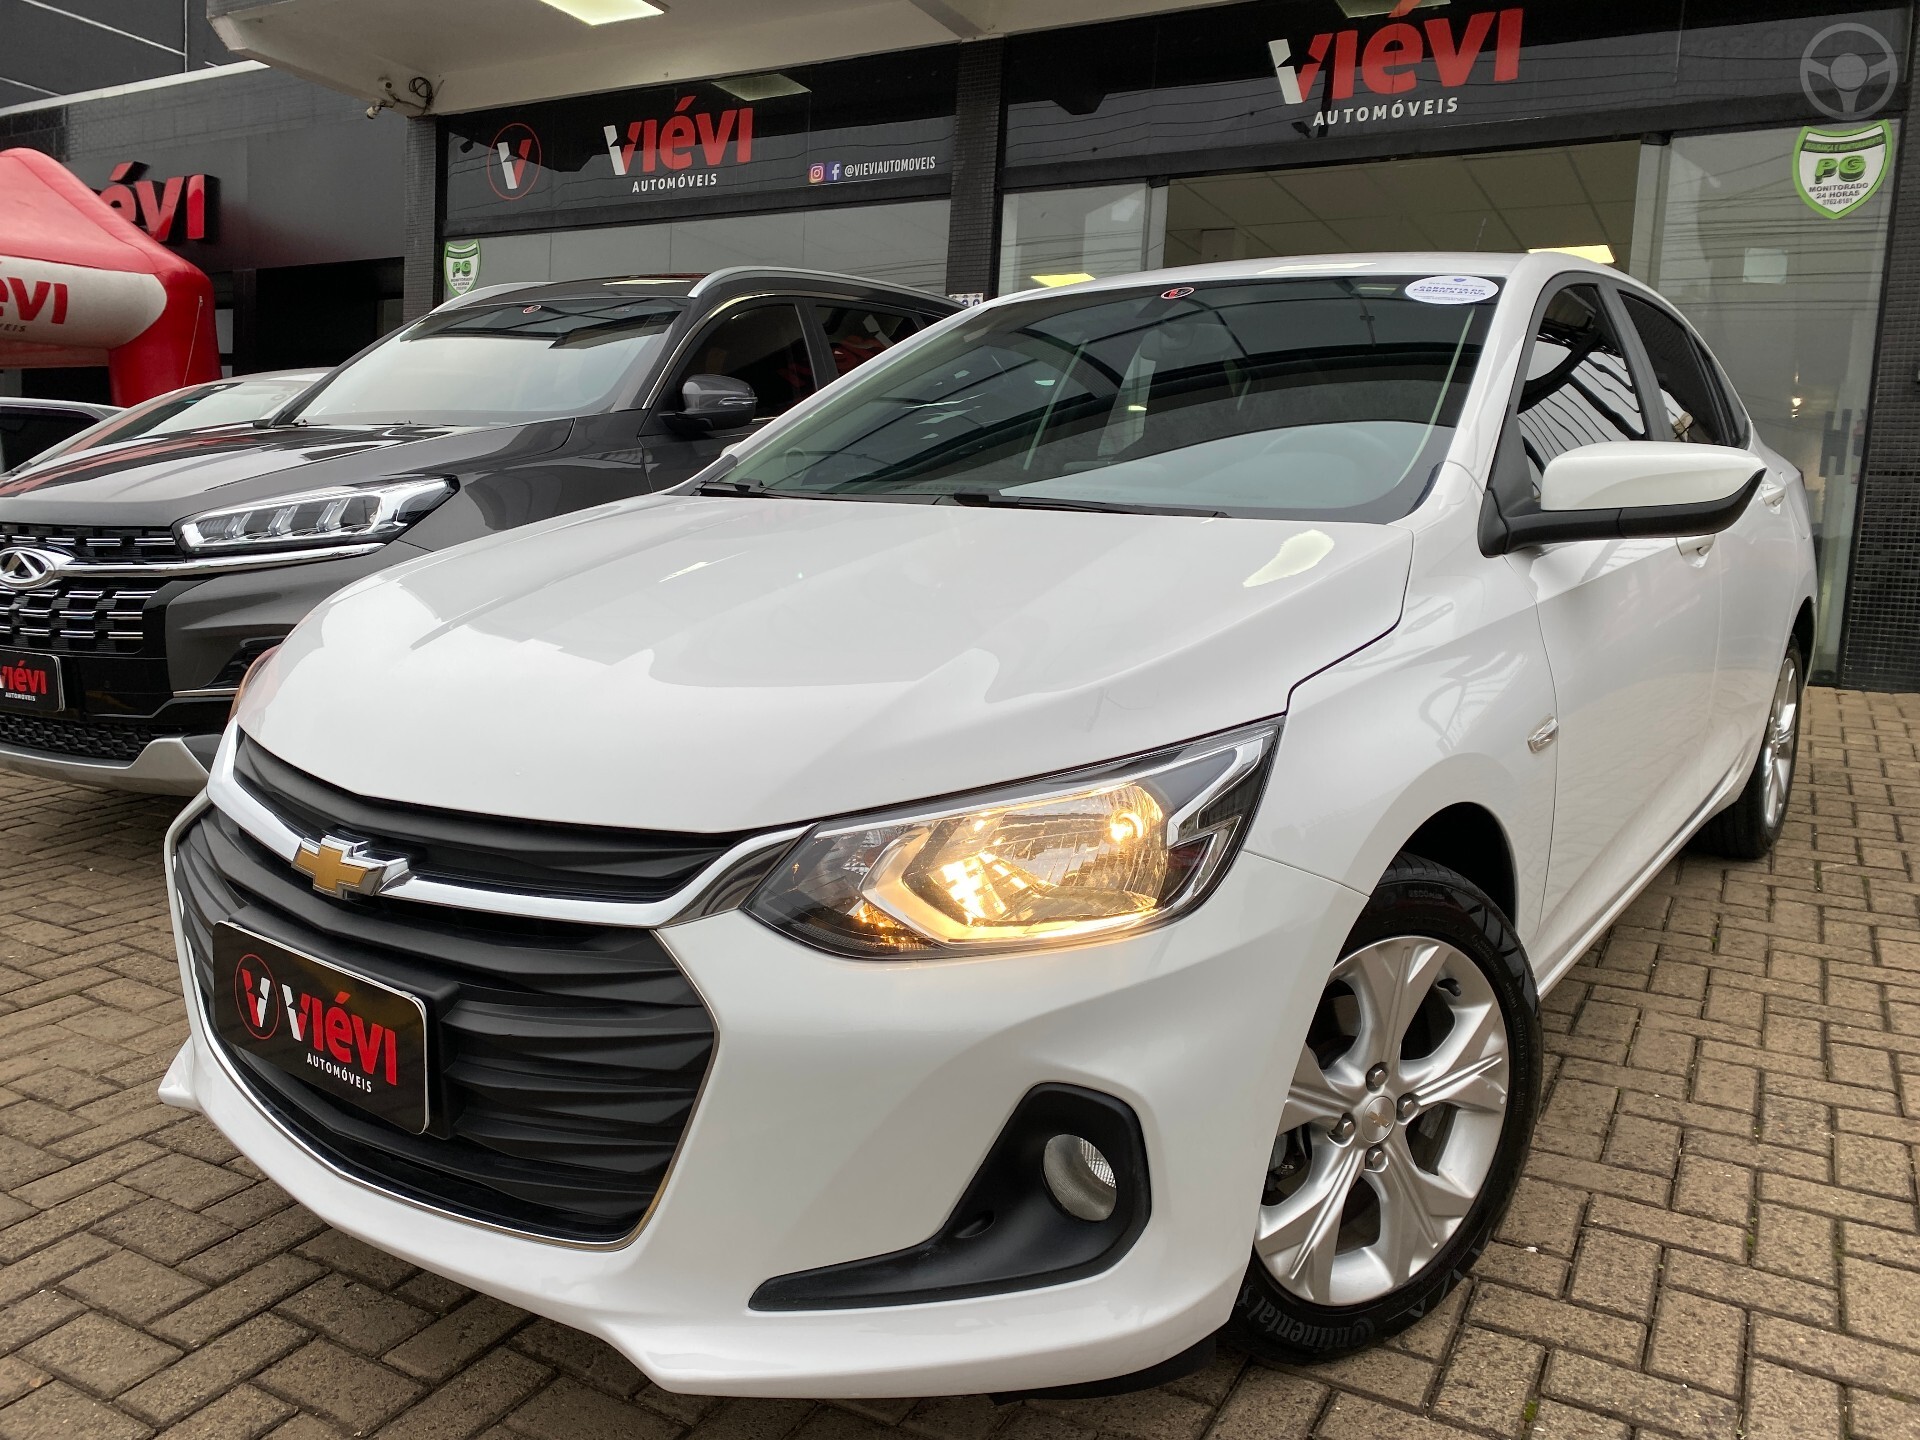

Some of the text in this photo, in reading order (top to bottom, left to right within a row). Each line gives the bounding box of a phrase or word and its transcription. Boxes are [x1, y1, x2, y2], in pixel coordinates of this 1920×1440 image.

[1312, 97, 1459, 127] AUTOMÓVEIS
[844, 156, 936, 178] @VIEVIAUTOMOVEIS
[1814, 155, 1867, 185] PG
[632, 173, 718, 193] AUTOMÓVEIS
[1808, 182, 1869, 193] MONITORADO
[1829, 190, 1860, 198] HORAS
[99, 161, 206, 242] éVI
[306, 1052, 373, 1094] AUTOMÓVEIS
[1246, 1295, 1376, 1353] Continental
